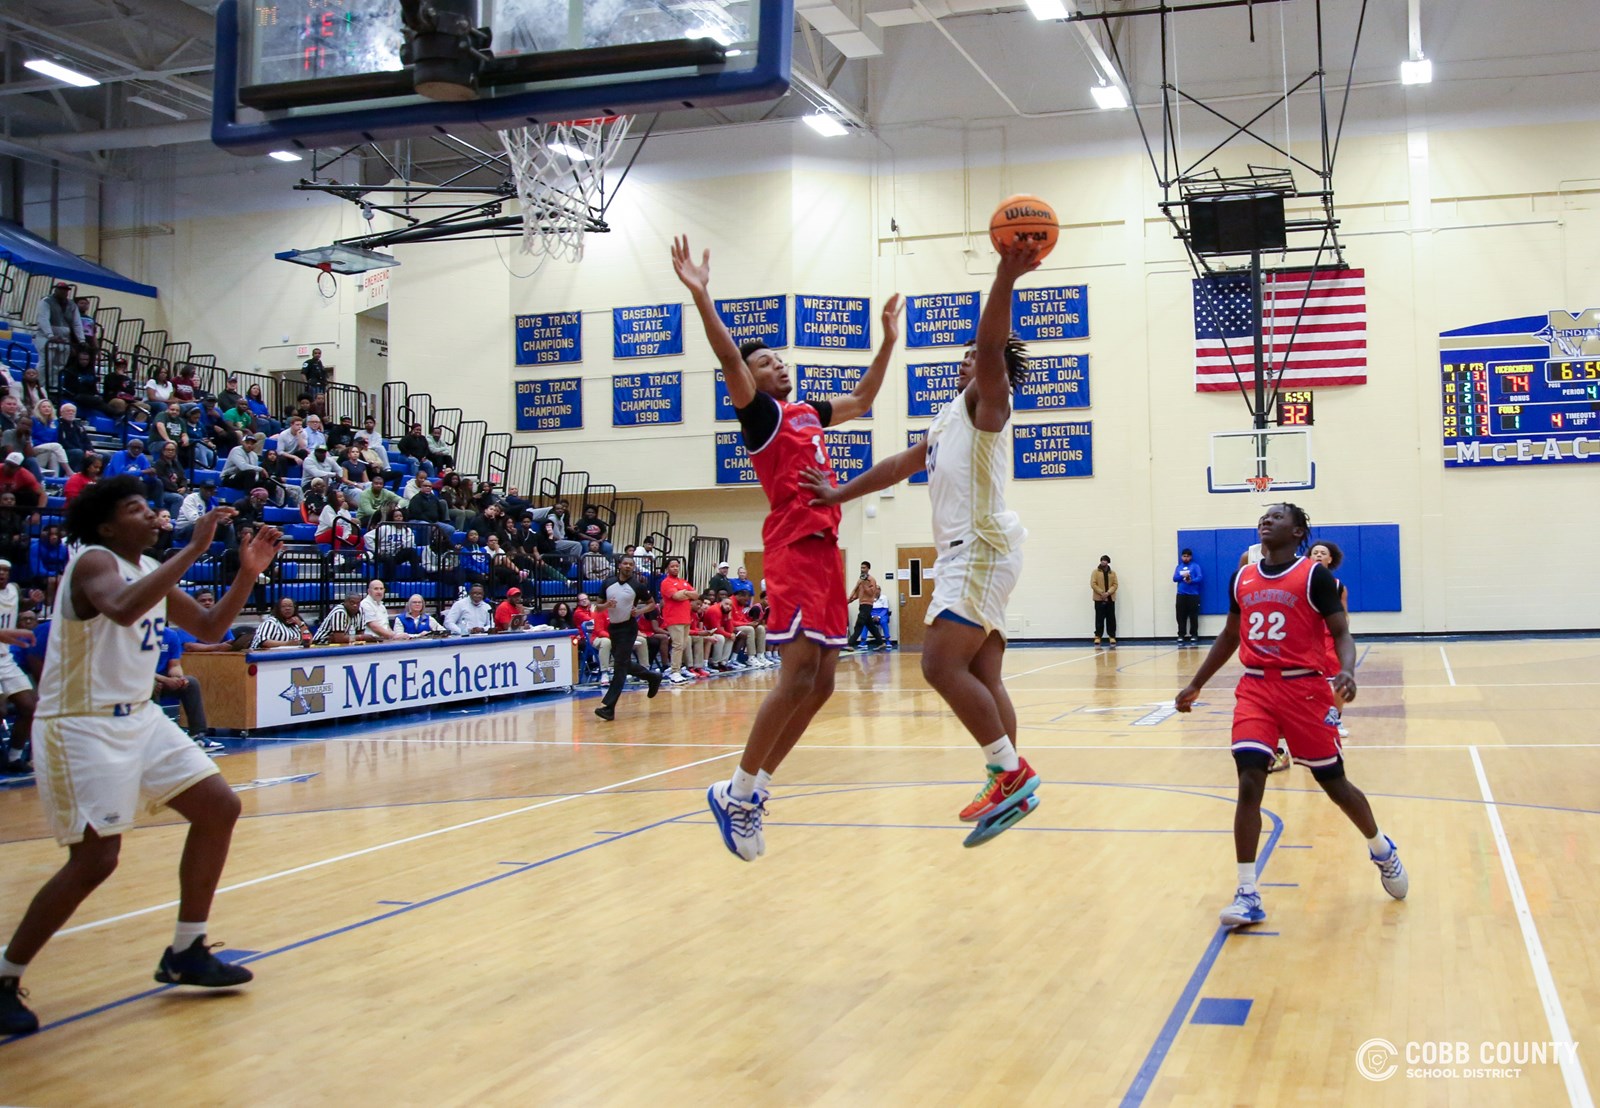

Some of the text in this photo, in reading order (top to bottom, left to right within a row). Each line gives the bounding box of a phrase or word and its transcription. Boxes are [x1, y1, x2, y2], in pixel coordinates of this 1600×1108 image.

[914, 295, 972, 308] WRESTLING
[1019, 289, 1079, 302] WRESTLING
[722, 299, 779, 312] WRESTLING
[804, 298, 862, 310] WRESTLING
[1032, 302, 1066, 313] STATE
[622, 307, 670, 320] BASEBALL
[734, 312, 766, 324] STATE
[816, 312, 850, 322] STATE
[927, 308, 959, 320] STATE
[518, 315, 578, 328] BOYS TRACK
[632, 320, 662, 331] STATE
[914, 320, 972, 332] CHAMPIONS
[1020, 314, 1079, 326] CHAMPIONS
[534, 328, 562, 338] STATE
[729, 324, 778, 336] HAMPIONS
[804, 322, 862, 335] CHAMPIONS
[1037, 327, 1063, 337] 1992
[621, 331, 671, 343] CHAMPIONS
[820, 336, 847, 346] 1990
[932, 333, 955, 343] 1991
[523, 338, 574, 351] CHAMPIONS
[636, 344, 659, 354] 1987
[537, 351, 560, 362] 1963
[1028, 358, 1078, 370] RESTLING
[805, 368, 861, 378] WRESTLING
[915, 365, 960, 377] WRESTLI
[1024, 370, 1084, 382] TATE DUAL
[1473, 371, 1486, 380] 31
[1561, 362, 1600, 380] 6:5
[518, 381, 577, 393] BOYS TRACK
[614, 375, 678, 388] GIRLS TRACK
[801, 380, 860, 390] STATE DUA
[927, 377, 959, 388] STATE
[1446, 382, 1486, 392] 10 2 17
[1506, 375, 1529, 392] 74
[632, 388, 662, 398] STATE
[1022, 382, 1078, 395] CHAMPIONS
[1587, 386, 1597, 398] 4
[534, 394, 563, 404] STATE
[916, 390, 959, 401] CHAMPIO
[1037, 396, 1065, 406] 2003
[1285, 392, 1311, 402] 6:59
[1446, 393, 1486, 403] 11 2 7
[523, 405, 572, 417] CHAMPIONS
[621, 399, 670, 411] CHAMPIONS
[1447, 406, 1456, 414] 15
[1477, 404, 1487, 413] 11
[635, 412, 659, 422] 1998
[1283, 406, 1308, 424] 32
[1444, 416, 1487, 426] 23 0 3
[1552, 414, 1562, 427] 4
[538, 418, 560, 428] 1998
[1015, 425, 1090, 438] GIRLS BASKETBALL
[1444, 427, 1488, 437] 25 4 5
[717, 434, 737, 444] GIRLS
[824, 434, 869, 444] BASKETBALL
[1035, 438, 1069, 449] STATE
[826, 447, 851, 456] TATE
[1456, 437, 1600, 463] McEAC
[1023, 451, 1082, 463] CHAMPIONS
[1041, 464, 1066, 474] 2016
[1, 614, 11, 628] 11
[1248, 612, 1286, 640] 22
[141, 618, 164, 651] 25
[342, 654, 518, 708] McEachern
[304, 685, 332, 694] INDIANS
